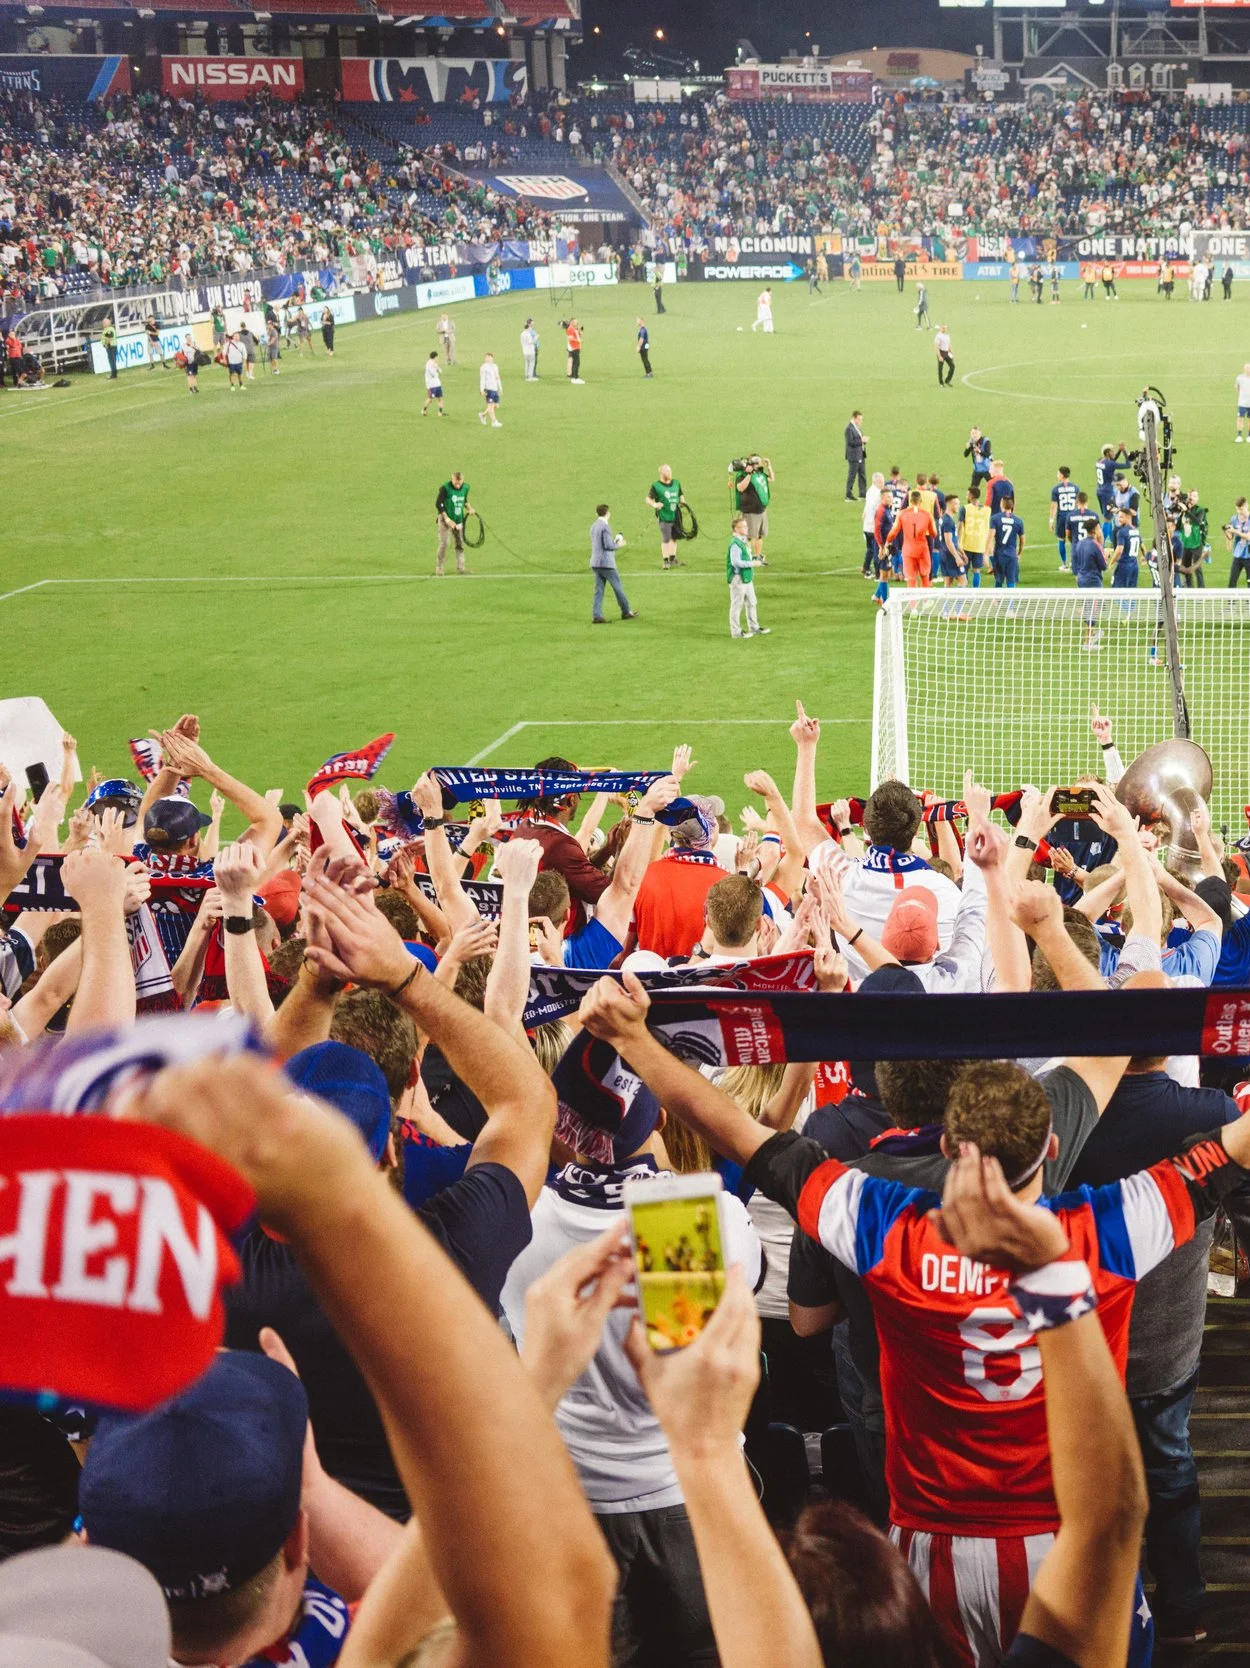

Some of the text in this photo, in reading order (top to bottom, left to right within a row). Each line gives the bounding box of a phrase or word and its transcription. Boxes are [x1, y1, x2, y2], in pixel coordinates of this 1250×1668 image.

[170, 62, 297, 86] NISSAN
[761, 71, 829, 84] PUCKETT'S
[1078, 238, 1116, 256] ONE
[1208, 237, 1248, 256] ONE
[405, 244, 463, 268] ONE TEAM.
[569, 270, 596, 287] eep
[704, 265, 793, 279] POWERADE
[932, 267, 960, 276] TIRE
[976, 265, 1004, 277] AT&T
[223, 279, 262, 307] EQUPO
[374, 292, 400, 316] Corona
[1096, 469, 1104, 485] 9
[1058, 493, 1077, 511] 25
[912, 522, 917, 540] 1
[1001, 524, 1013, 545] 7
[1077, 522, 1088, 541] 5
[1128, 536, 1141, 557] 10
[474, 785, 526, 795] Nashville,
[529, 782, 542, 792] TN
[957, 1306, 1044, 1403] 8
